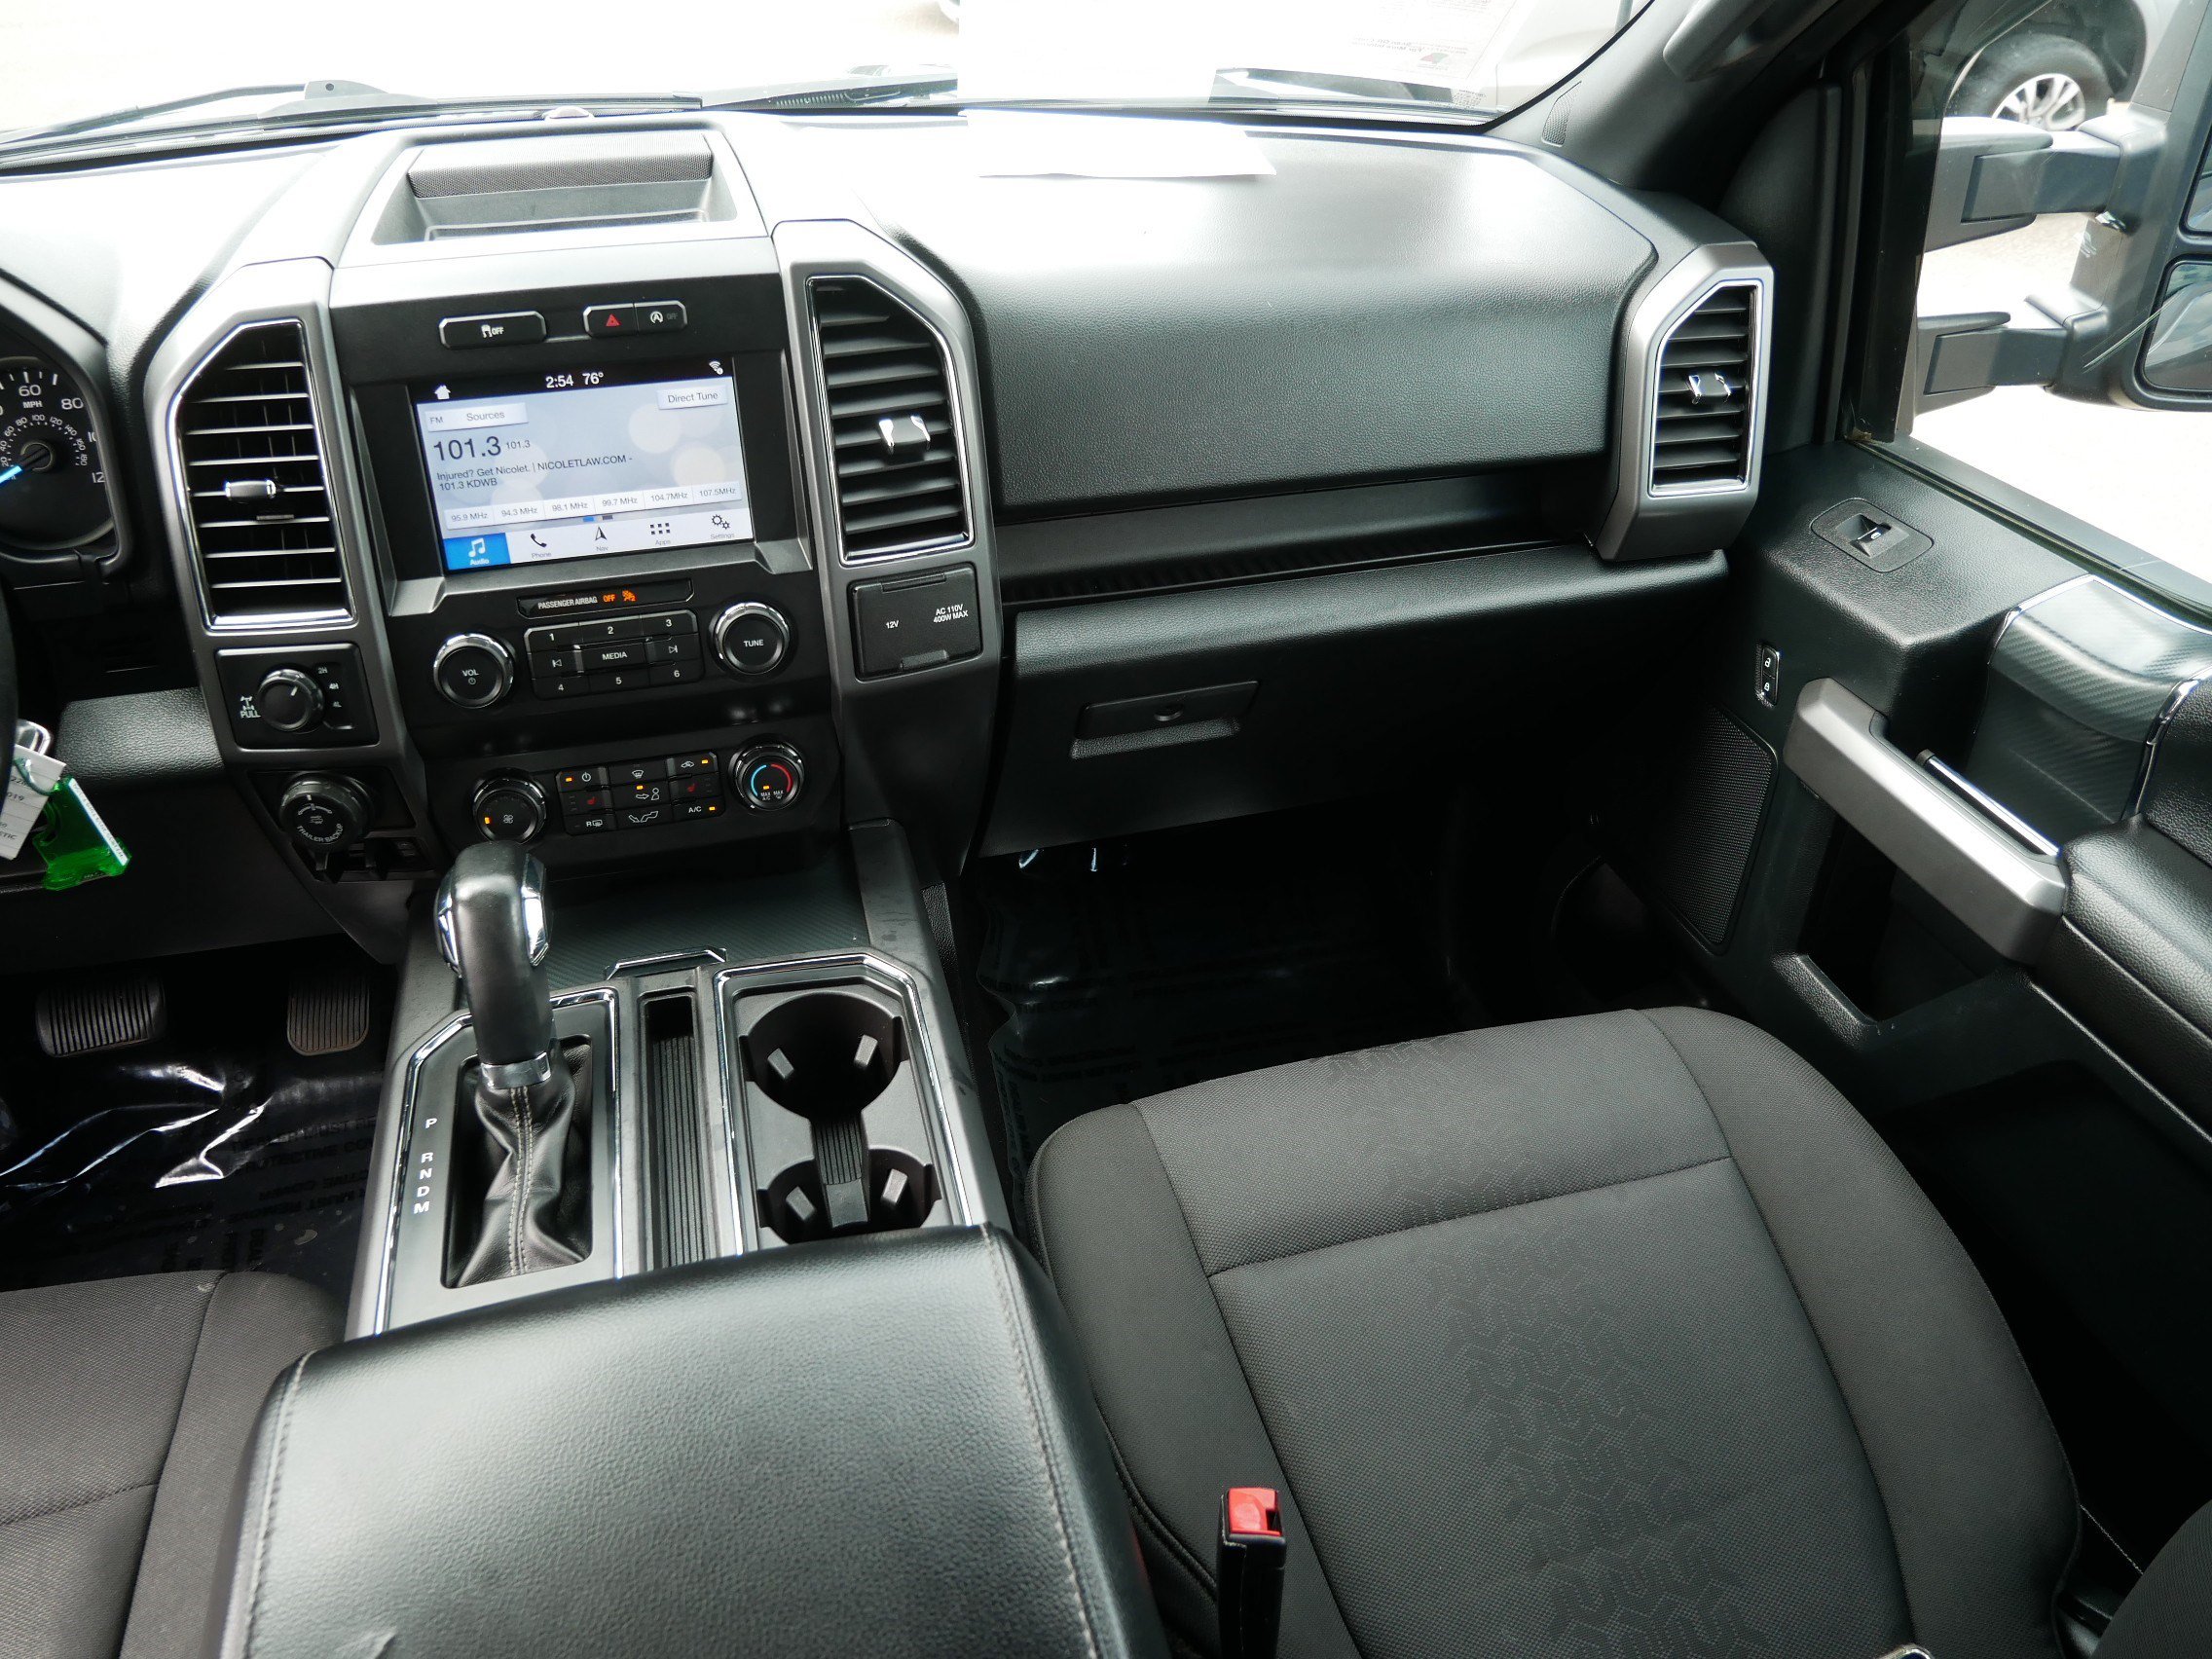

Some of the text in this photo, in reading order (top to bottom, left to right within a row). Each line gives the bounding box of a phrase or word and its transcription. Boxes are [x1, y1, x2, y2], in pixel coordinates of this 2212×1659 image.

[666, 313, 679, 321] OFF
[491, 327, 504, 336] OFF
[545, 371, 604, 388] 2:54 76°
[18, 384, 42, 397] 60
[667, 390, 719, 404] Direct Tune
[22, 400, 43, 409] MPH
[60, 397, 84, 410] 80
[50, 416, 63, 425] 120
[429, 416, 444, 424] FM
[466, 410, 505, 422] Sources
[16, 417, 28, 426] 80
[4, 425, 15, 437] 60
[64, 424, 78, 436] 140
[0, 440, 7, 452] 40
[433, 435, 531, 462] 101.3 101.3
[1, 457, 9, 467] 20
[436, 468, 474, 482] Injured?
[476, 466, 494, 477] Get
[536, 455, 626, 472] NICOLETLAW.COM
[439, 477, 498, 492] 101.3 KDWB
[570, 501, 588, 511] MHz
[601, 496, 638, 507] 99.7 MHz
[469, 511, 489, 521] MHz
[500, 505, 538, 518] 94.3 MHz
[710, 532, 735, 541] Settings
[655, 538, 672, 547] Apps
[469, 558, 490, 567] Audio
[537, 594, 616, 609] PASSENGER AIRBAG OFF
[936, 604, 964, 615] AC 110V
[934, 609, 969, 623] 400W MAX
[665, 619, 673, 628] 3
[885, 620, 900, 629] 12V
[608, 626, 614, 635] 2
[743, 639, 764, 647] TUNE
[602, 650, 628, 661] MEDIA
[317, 666, 328, 675] 2H
[674, 670, 681, 679] 6
[615, 677, 622, 685] 5
[558, 683, 565, 692] 4
[240, 710, 261, 719] PULL
[688, 805, 702, 814] A/C
[297, 824, 344, 843] TRAILER BACKUP
[425, 1118, 437, 1128] P
[422, 1152, 433, 1163] R
[419, 1168, 432, 1179] N
[417, 1186, 430, 1197] D
[413, 1201, 430, 1214] M
